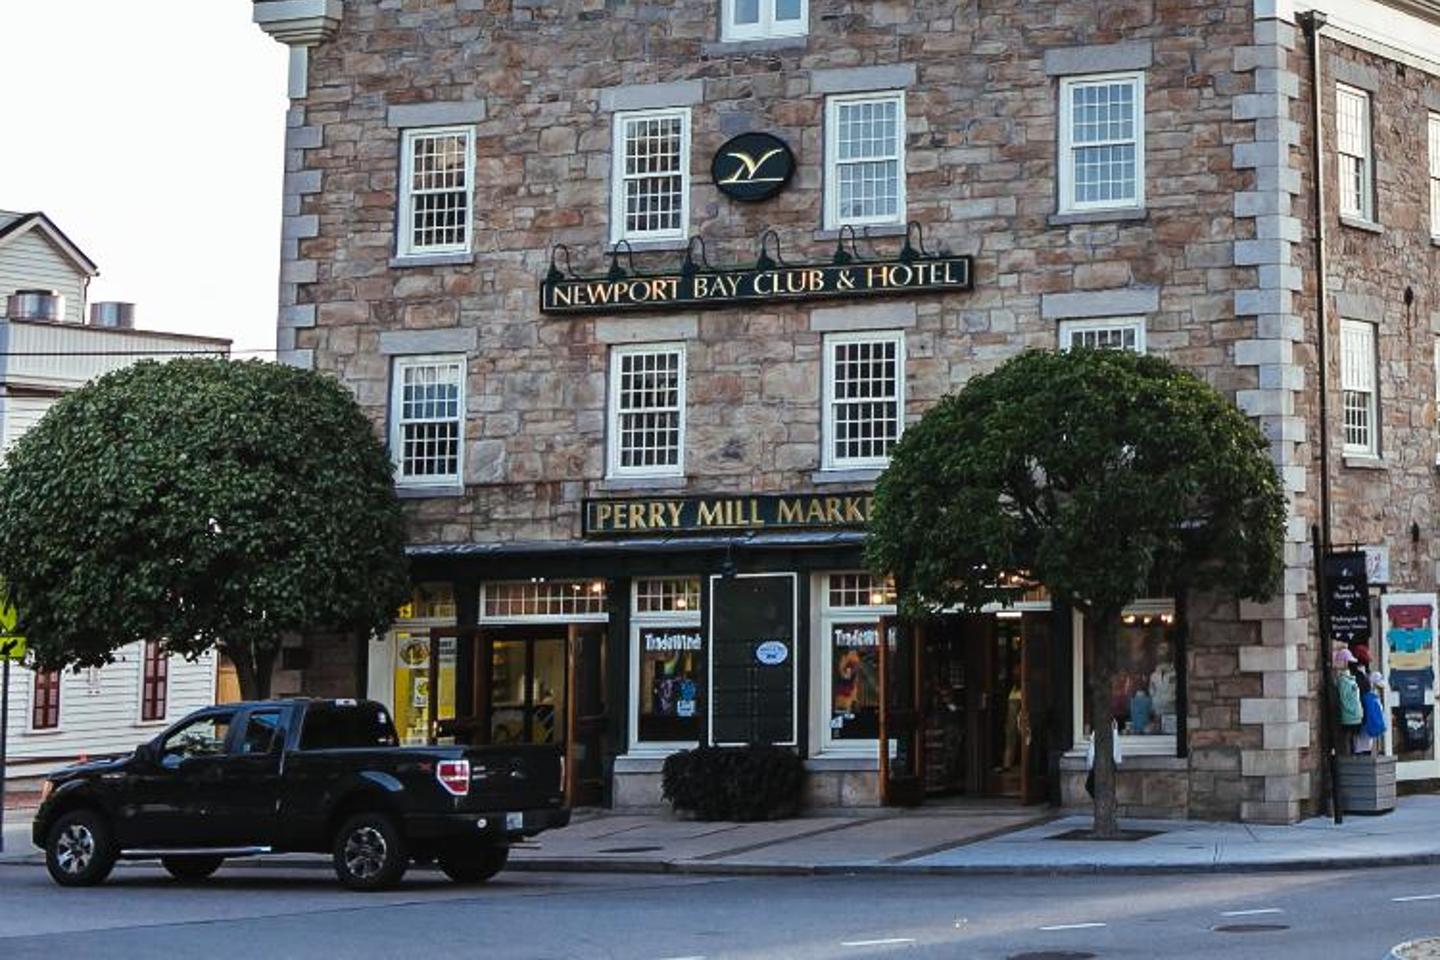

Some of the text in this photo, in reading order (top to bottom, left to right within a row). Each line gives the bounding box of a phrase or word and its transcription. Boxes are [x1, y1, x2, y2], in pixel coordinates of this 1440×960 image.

[552, 262, 957, 306] NEWPORT BAY CLUB & HOTEL
[596, 496, 875, 529] PERRY MILL MARKE
